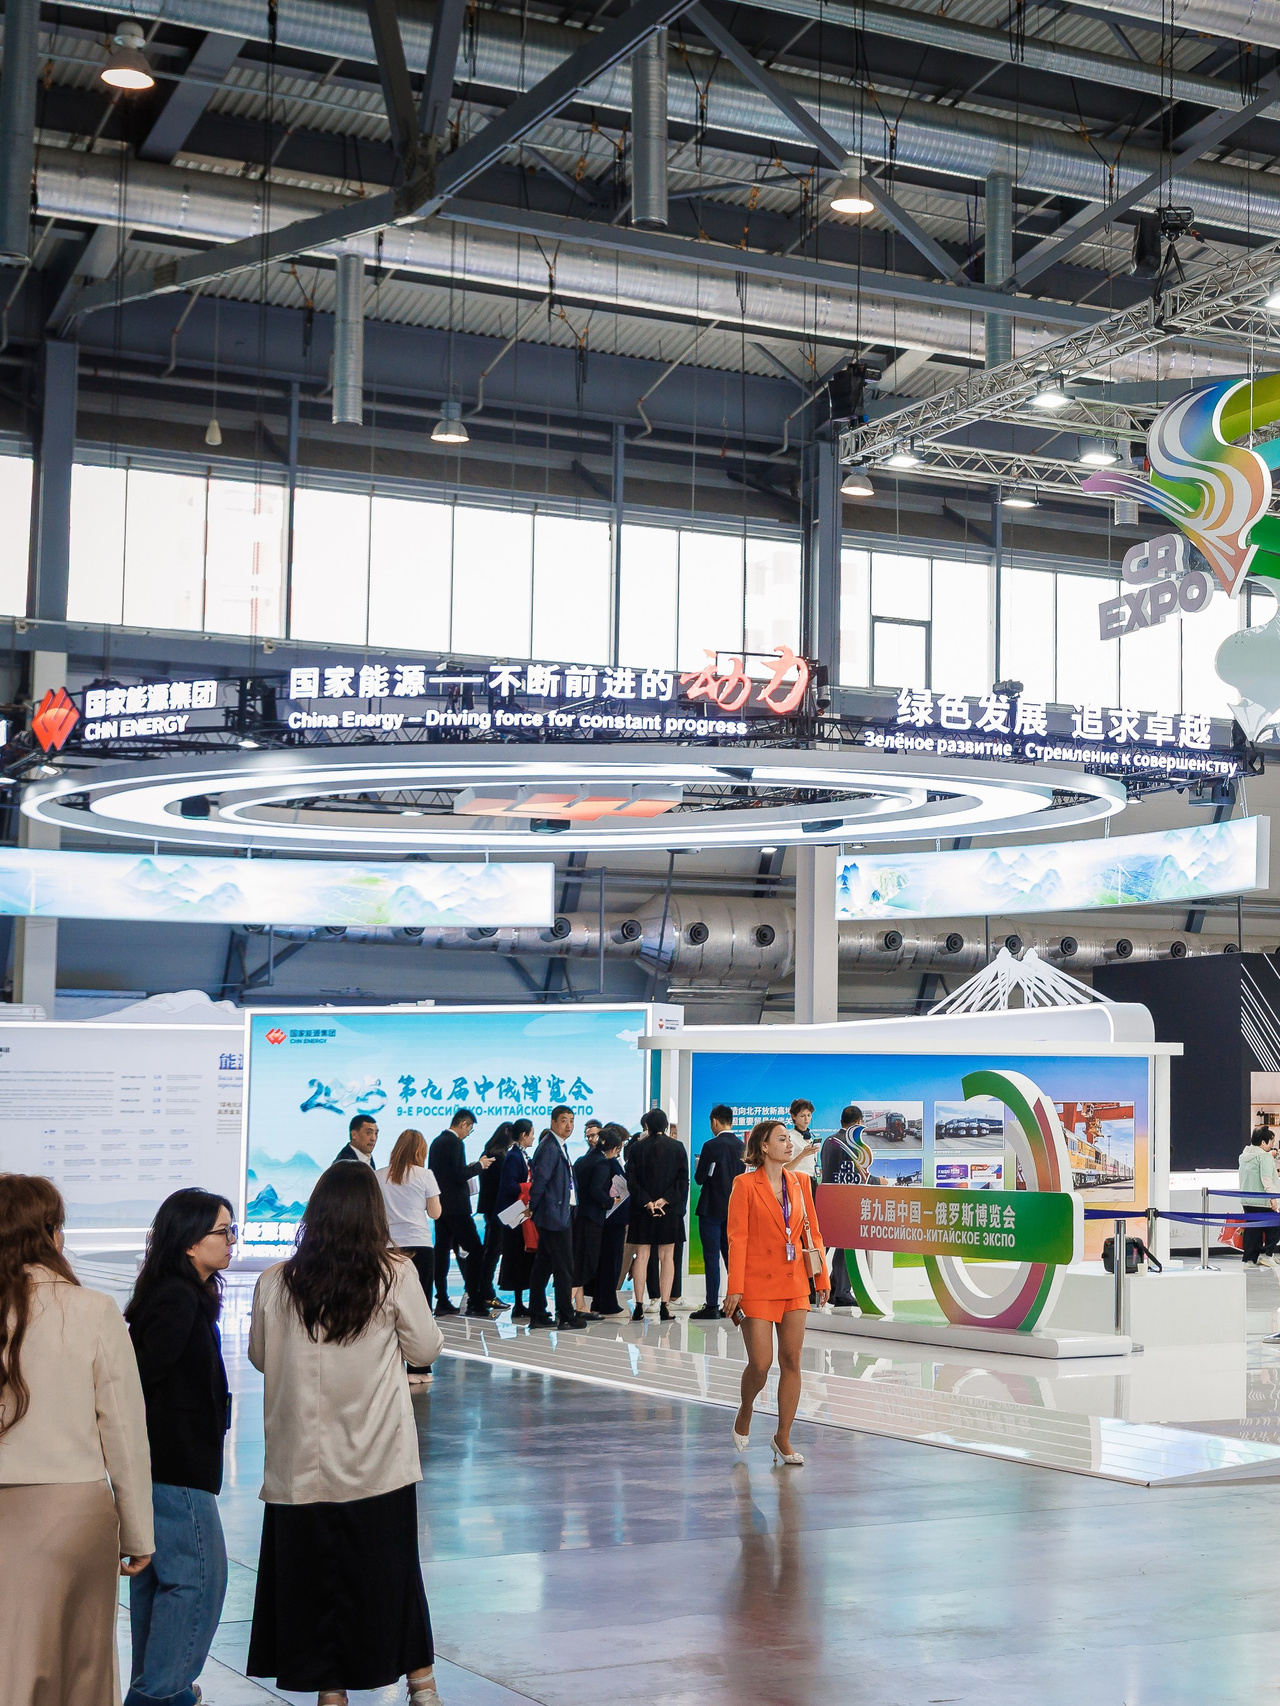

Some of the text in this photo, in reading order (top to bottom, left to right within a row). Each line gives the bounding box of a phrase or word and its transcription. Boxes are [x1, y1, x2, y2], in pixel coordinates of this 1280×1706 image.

[1099, 570, 1214, 641] EXPO
[85, 680, 218, 719] 国家能源集团
[84, 714, 190, 741] CHN ENERGY
[288, 712, 339, 729] China
[342, 710, 404, 731] Energy
[425, 709, 491, 730] Driving
[495, 709, 543, 727] force
[548, 710, 577, 728] for
[579, 713, 662, 731] constant
[665, 717, 748, 737] progress
[896, 687, 1213, 750] 绿色发展 追求卓越
[864, 730, 1238, 778] Зелёное развитие Стремление к совершенству
[396, 1074, 594, 1103] 第九届中俄博览会
[860, 1225, 1016, 1248] IX РОССИЙСКО-КИТАЙСКОЕ ЭКСПО
